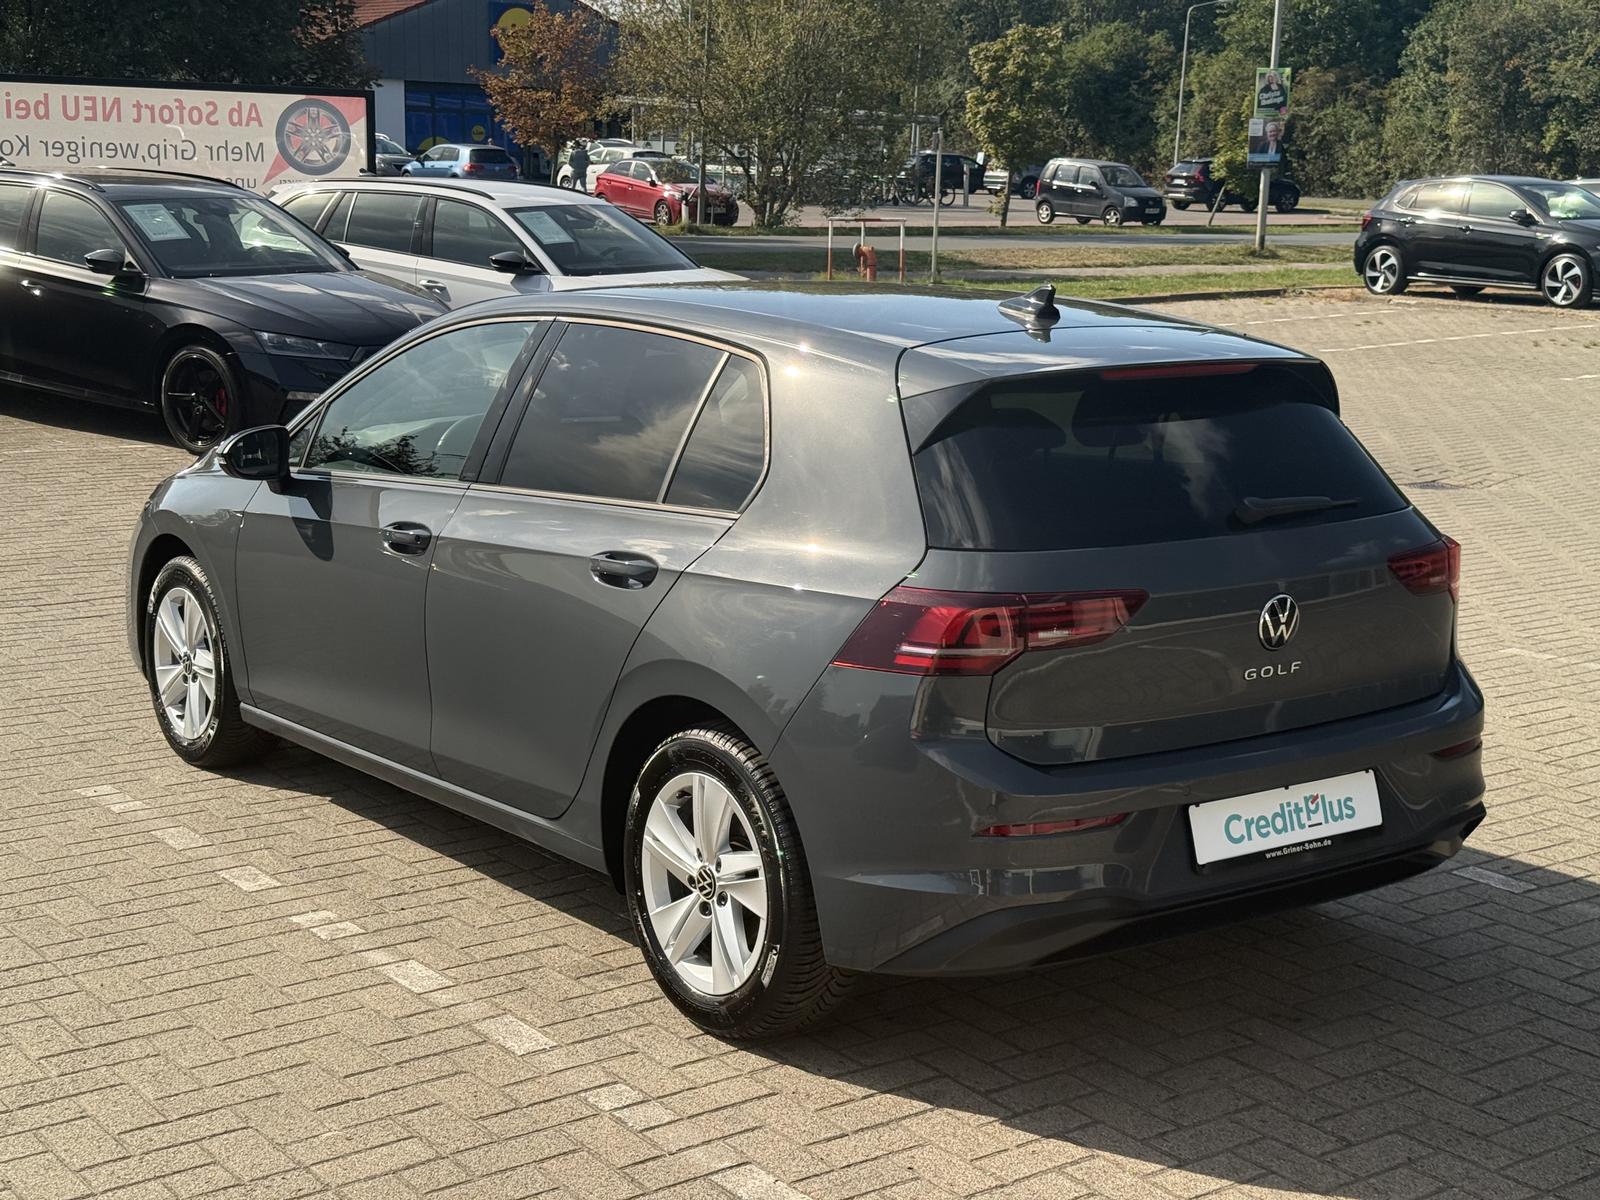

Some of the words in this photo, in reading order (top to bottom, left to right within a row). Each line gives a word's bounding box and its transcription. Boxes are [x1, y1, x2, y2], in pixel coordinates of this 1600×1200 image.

[1244, 661, 1303, 681] GOLF
[1224, 793, 1356, 845] CreditPlus
[1265, 838, 1333, 860] www.Griner-Sohn.de
